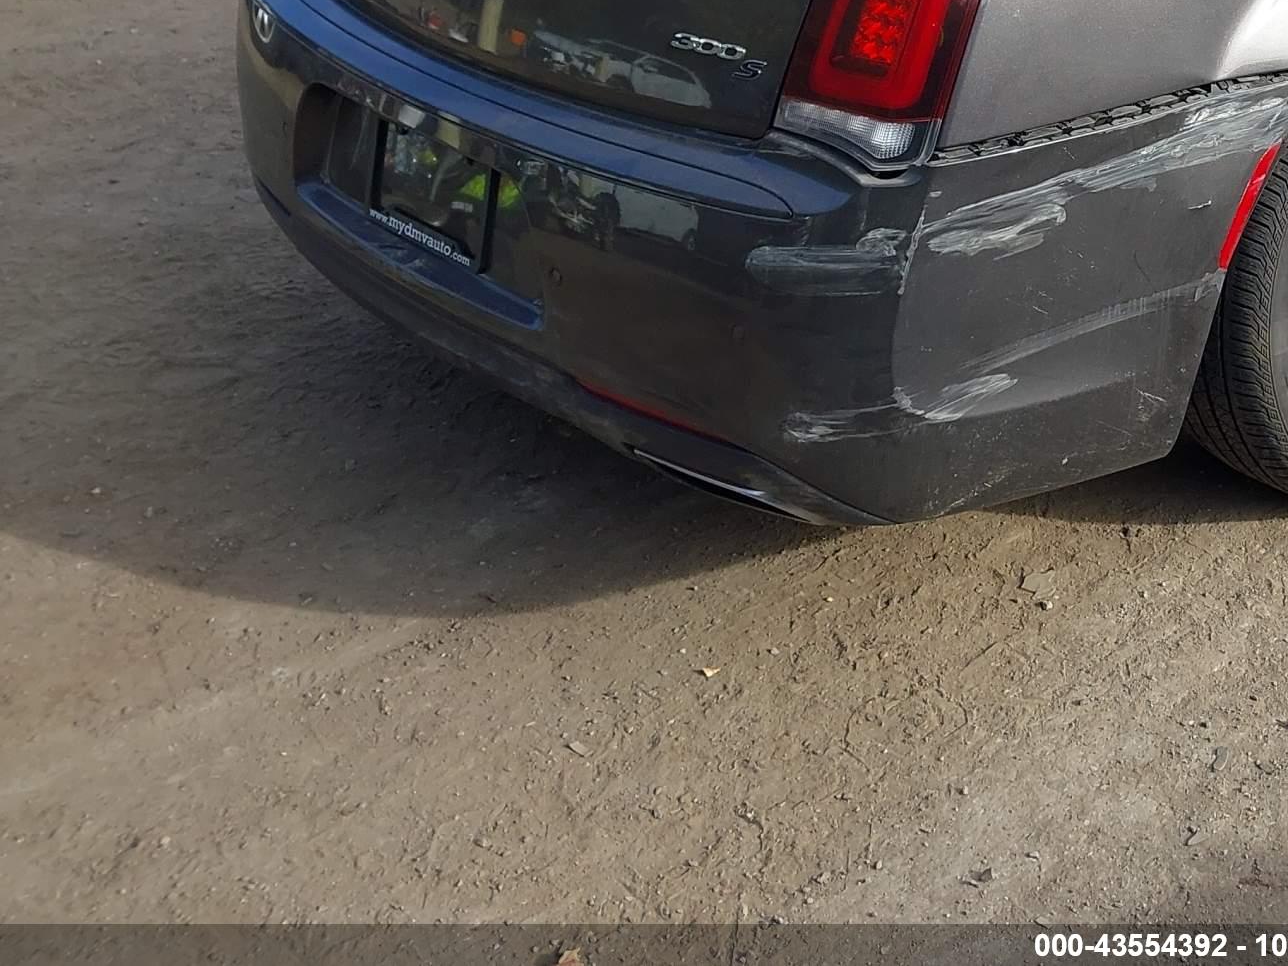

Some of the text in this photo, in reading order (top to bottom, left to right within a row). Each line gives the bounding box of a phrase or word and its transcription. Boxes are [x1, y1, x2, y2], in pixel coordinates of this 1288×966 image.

[670, 32, 768, 81] 300 S
[368, 207, 471, 267] www.mydmvauto.com
